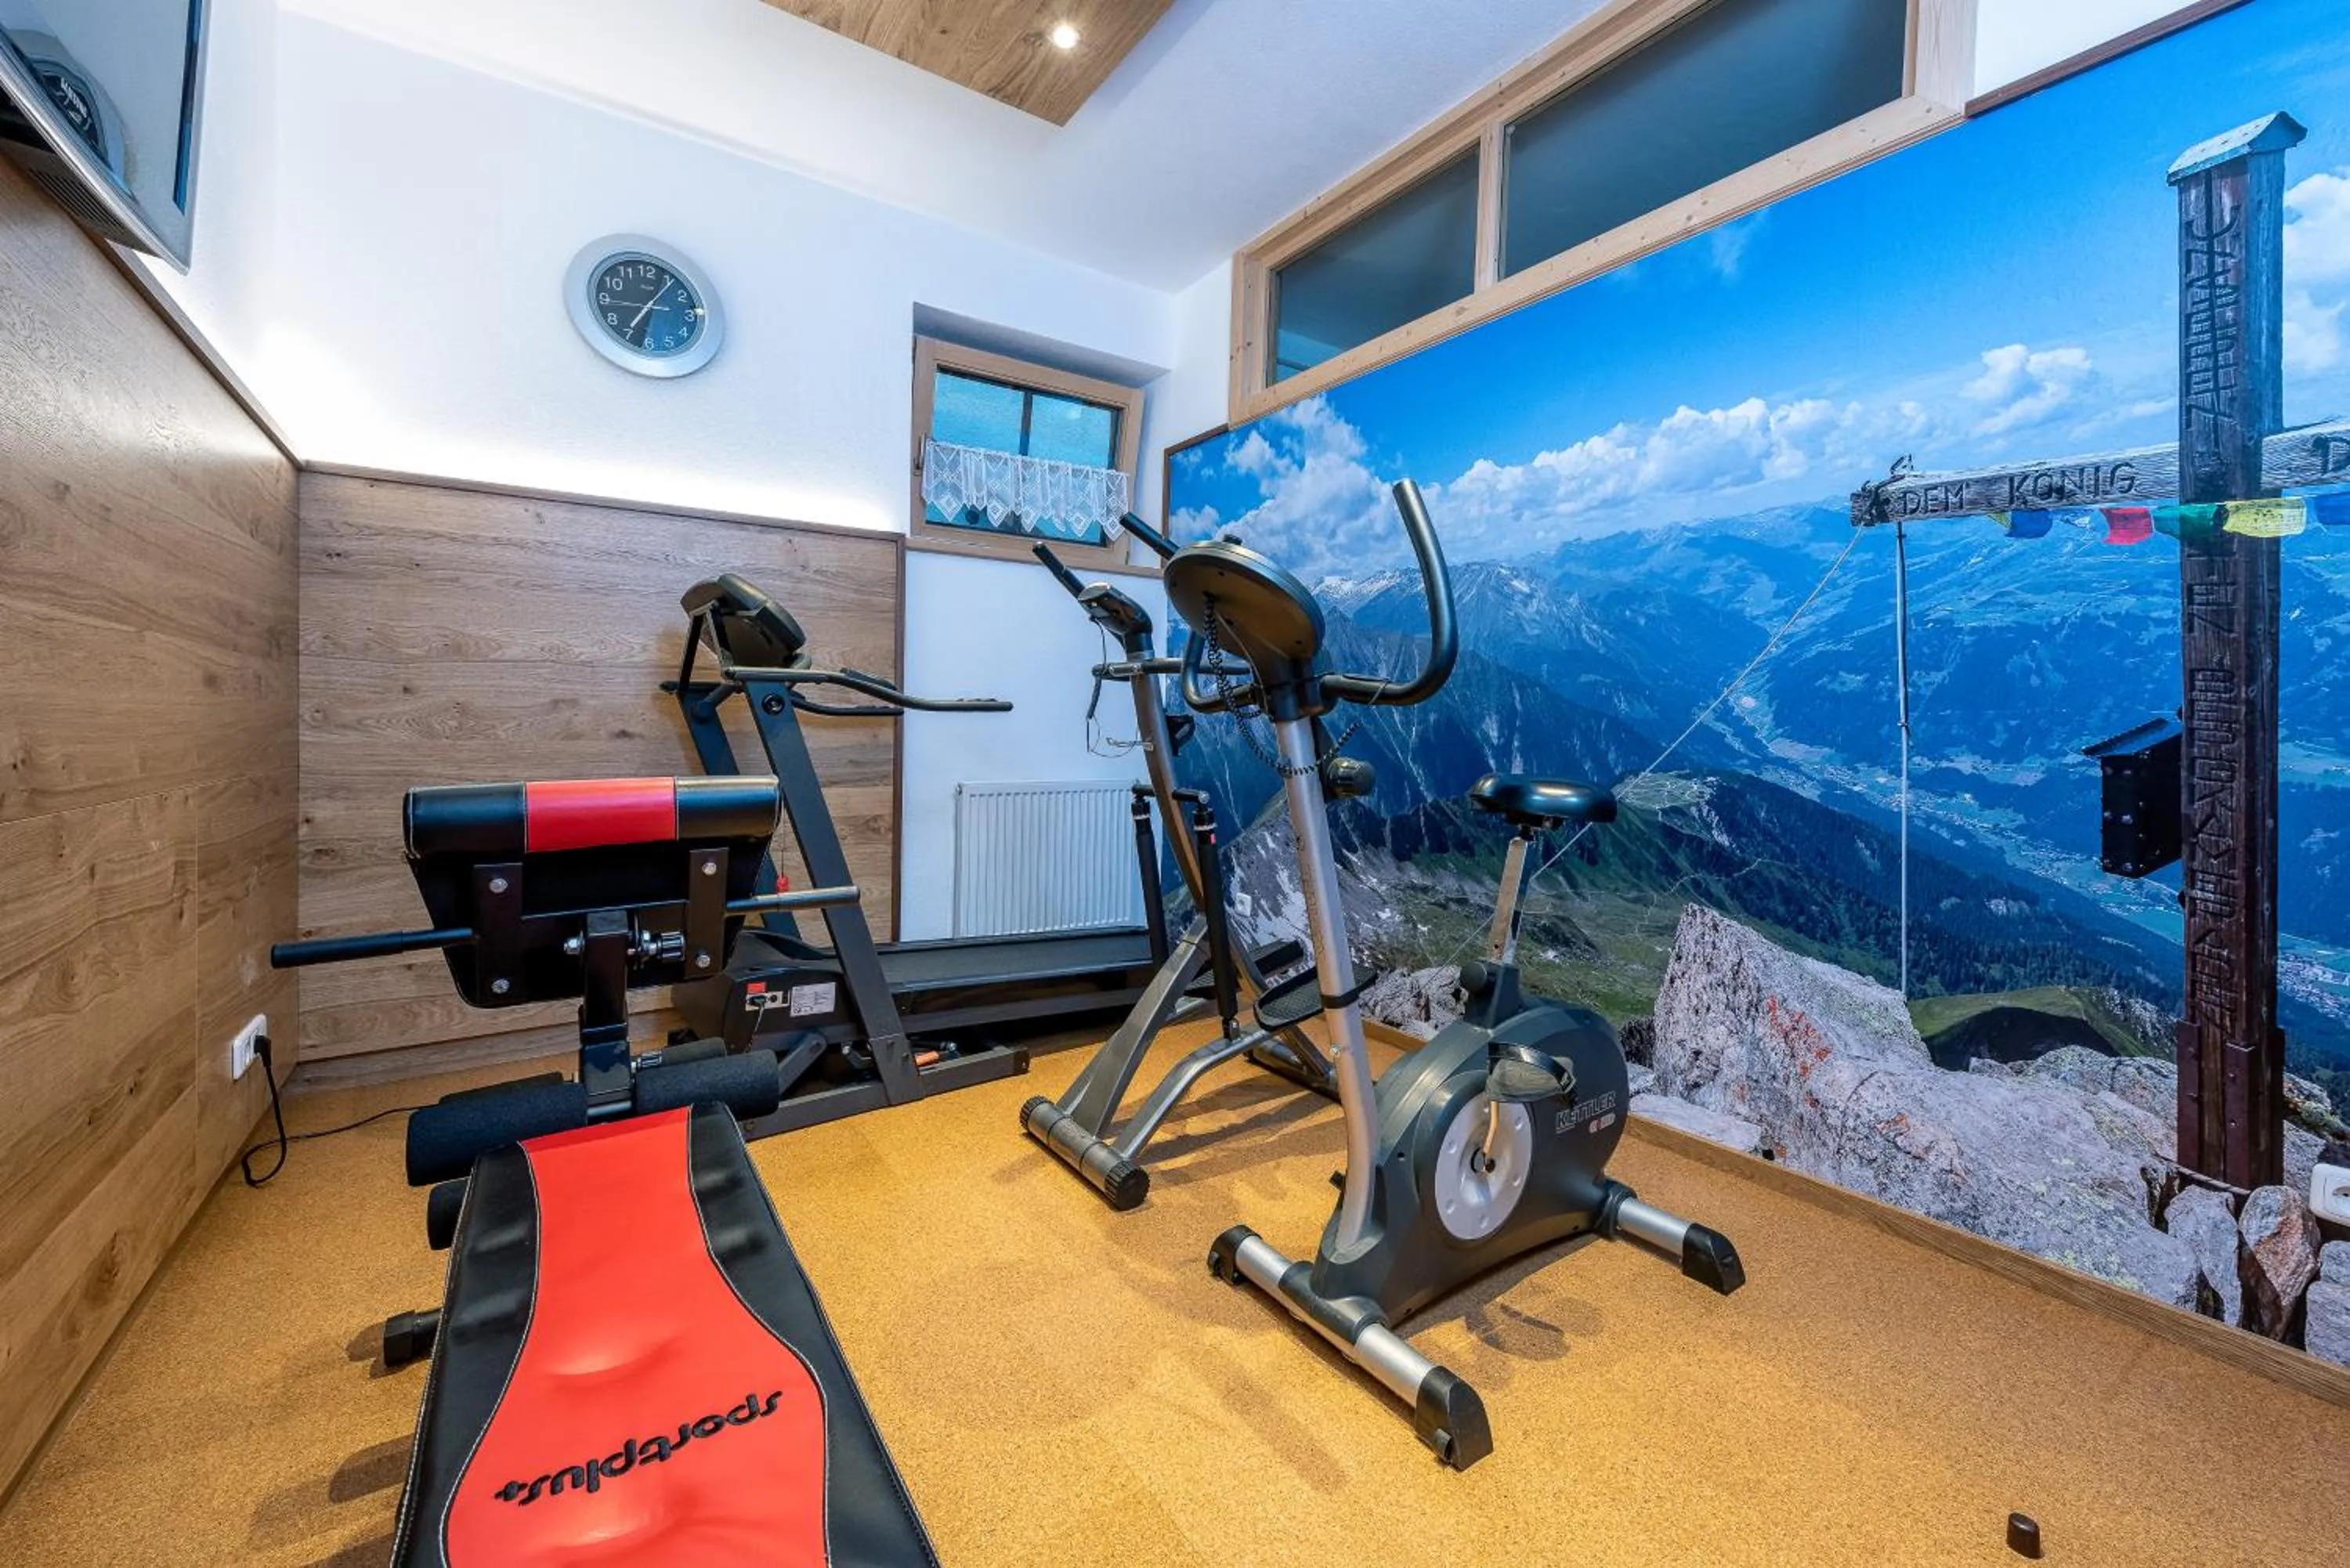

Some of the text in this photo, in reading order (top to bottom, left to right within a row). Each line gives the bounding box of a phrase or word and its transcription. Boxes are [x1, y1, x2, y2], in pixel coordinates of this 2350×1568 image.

[617, 266, 633, 280] 11
[638, 265, 656, 278] 12
[605, 276, 623, 291] 10
[599, 292, 609, 304] 9
[678, 290, 687, 302] 2
[607, 313, 617, 325] 8
[685, 309, 695, 322] 3
[623, 328, 634, 340] 7
[678, 327, 687, 338] 4
[645, 338, 654, 349] 6
[664, 336, 674, 347] 5
[1901, 482, 1967, 514] DEM
[2008, 462, 2136, 506] KÖNIG
[1556, 1090, 1616, 1129] KETTLER
[518, 1391, 782, 1506] sportplus
